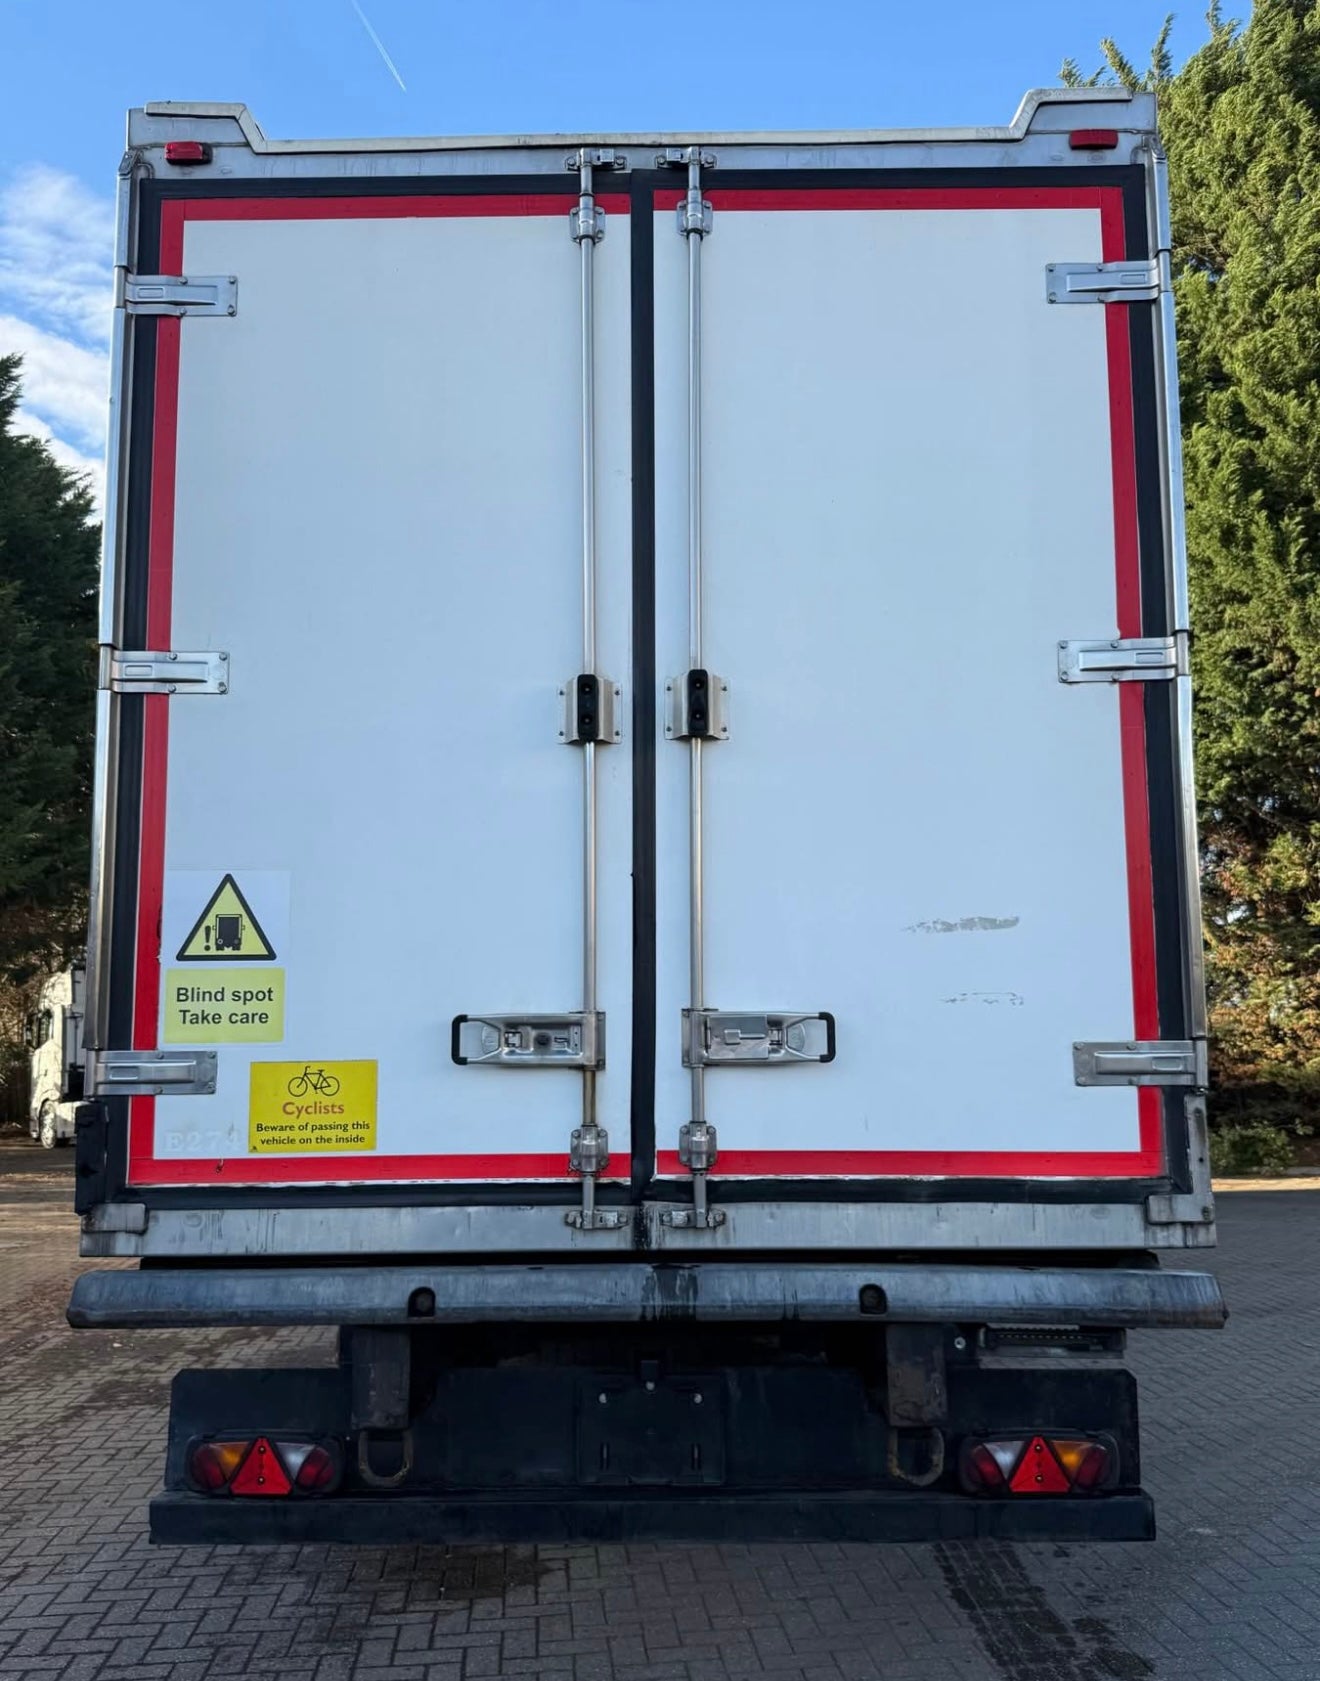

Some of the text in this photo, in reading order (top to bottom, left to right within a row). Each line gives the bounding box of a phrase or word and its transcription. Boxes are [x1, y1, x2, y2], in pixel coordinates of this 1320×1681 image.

[176, 987, 274, 1005] Blind spot
[179, 1009, 269, 1025] Take care
[282, 1101, 344, 1119] Cyclists
[256, 1121, 370, 1133] Beware of passing this
[260, 1135, 296, 1145] vehicle
[315, 1135, 333, 1144] the
[335, 1134, 365, 1144] inside
